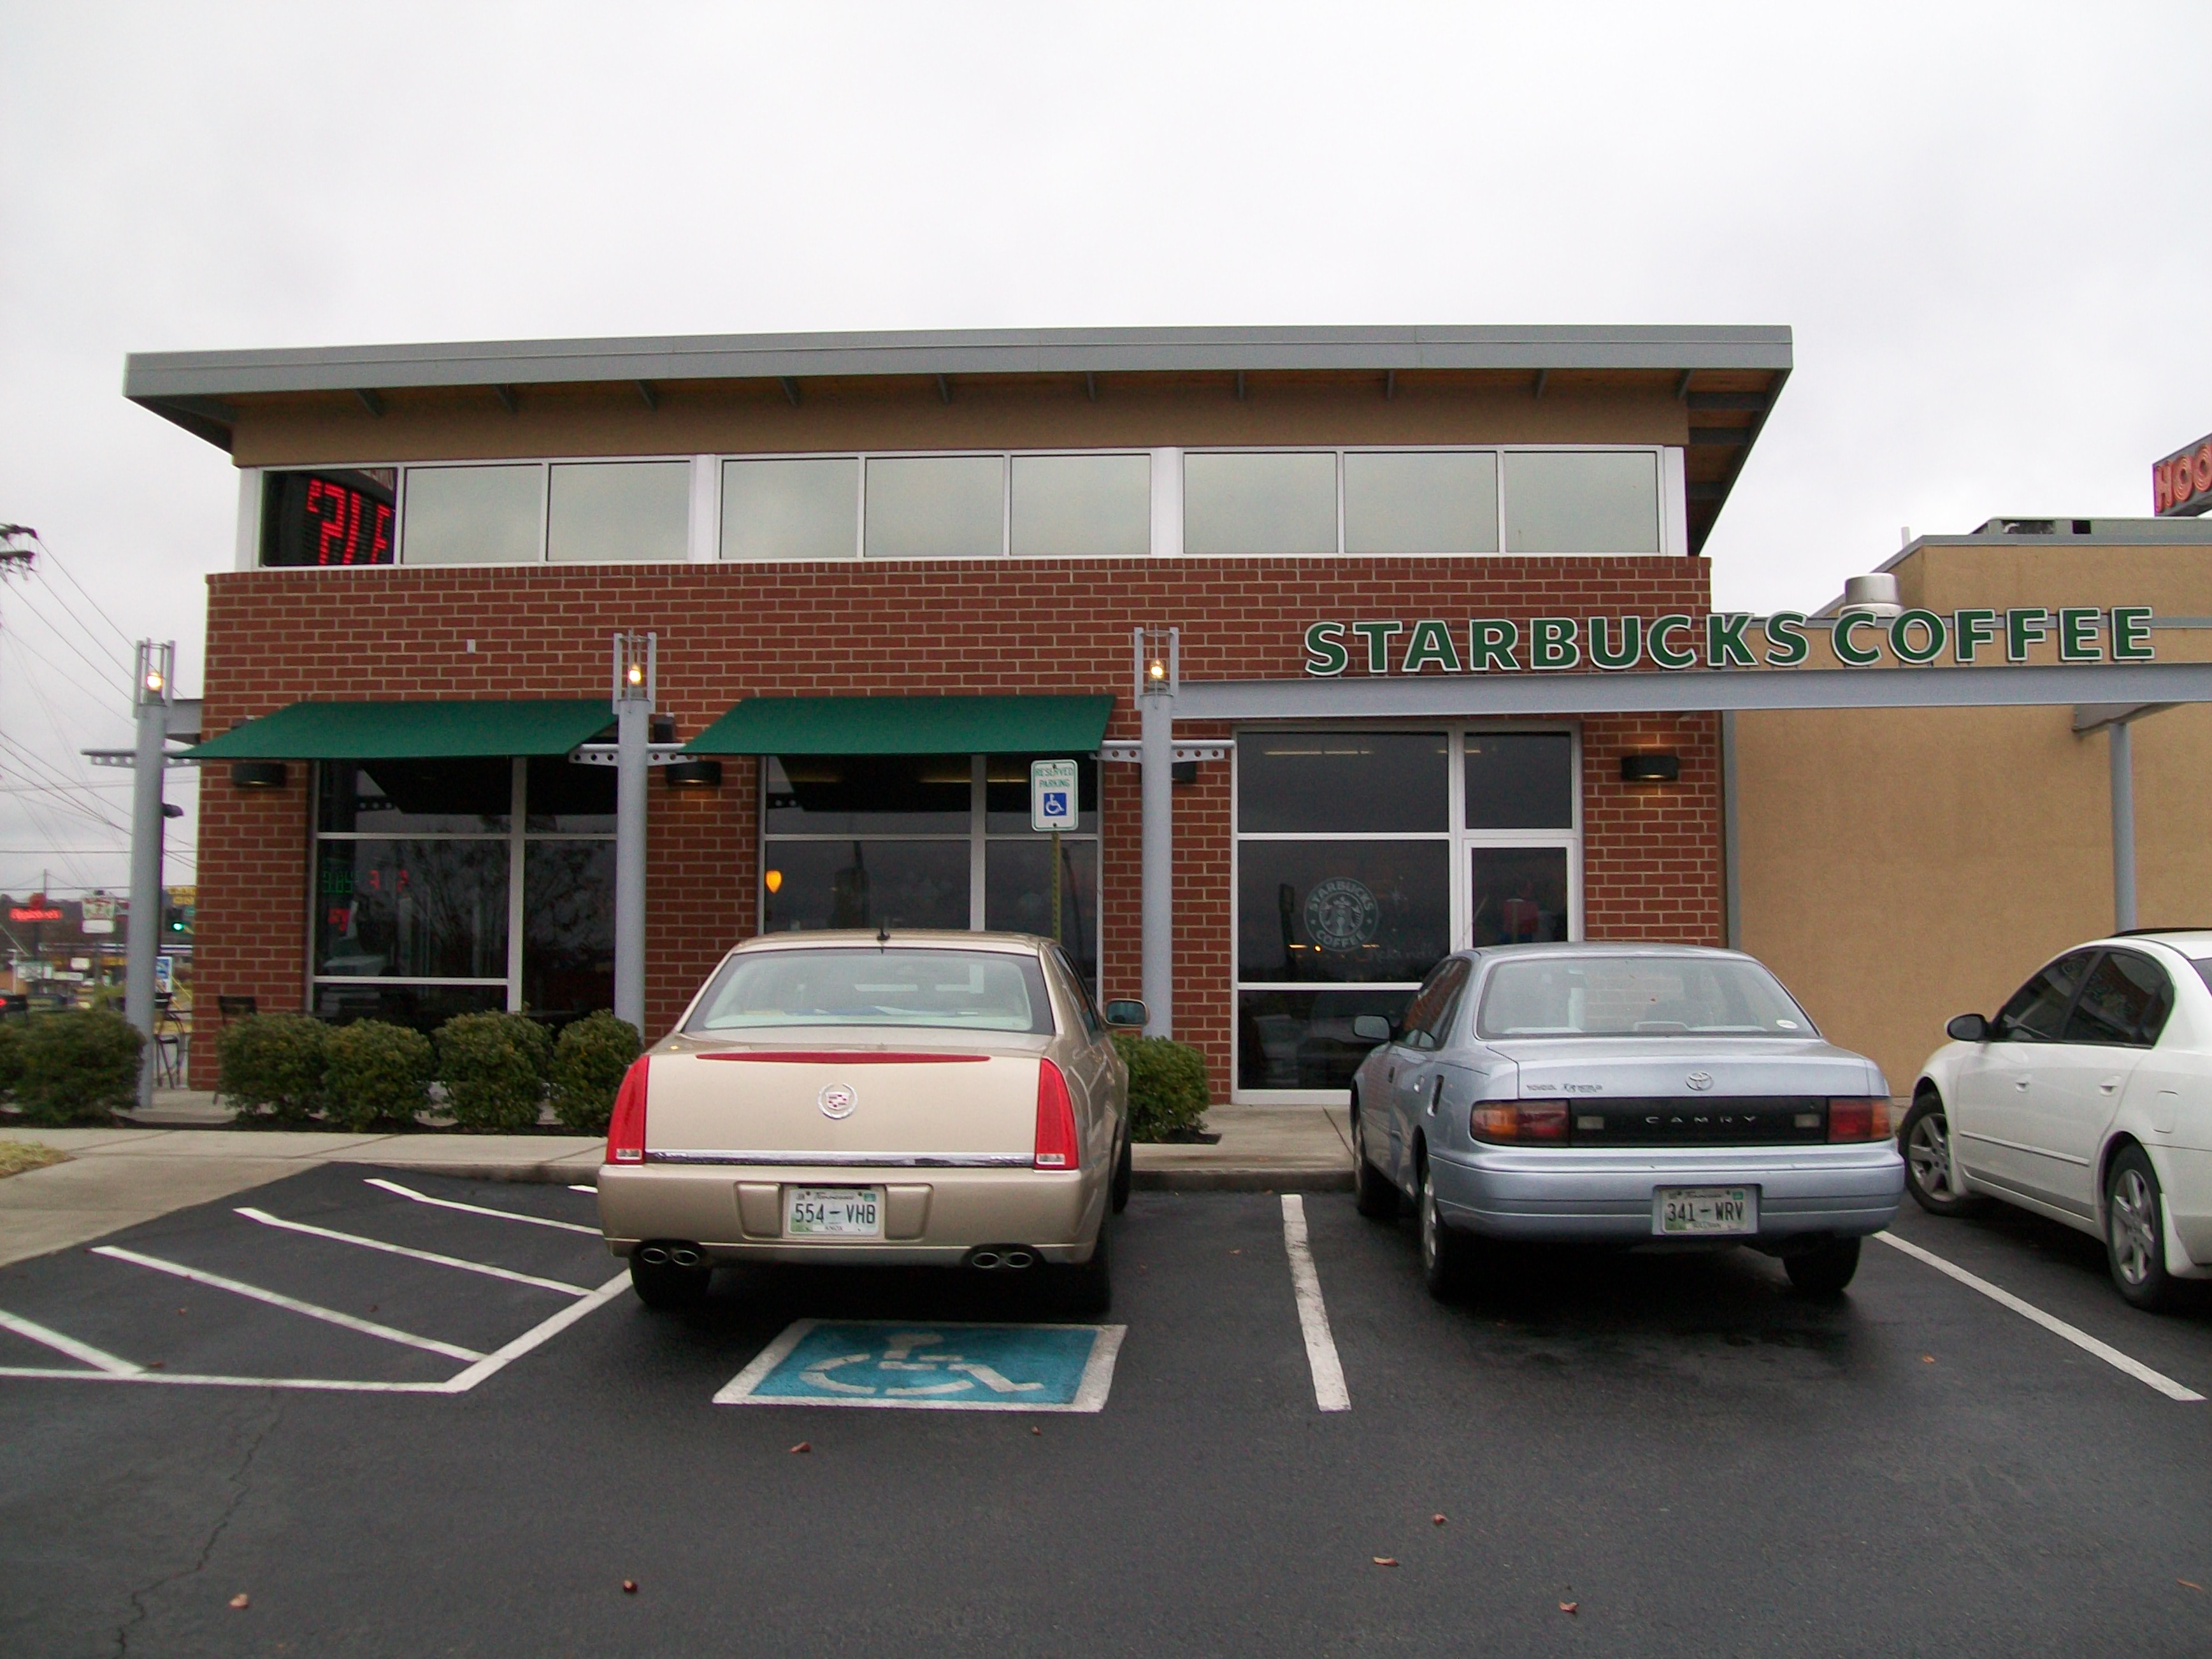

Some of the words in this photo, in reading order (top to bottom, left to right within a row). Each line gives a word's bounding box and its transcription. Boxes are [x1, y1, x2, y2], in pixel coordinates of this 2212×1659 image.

[1304, 611, 1809, 676] STARBUCKS
[1832, 607, 2155, 666] COFFEE
[1035, 767, 1073, 776] RESERVED
[1039, 779, 1070, 787] PARKING
[1309, 880, 1374, 912] STARBUCKS
[1316, 930, 1366, 948] COFFEE
